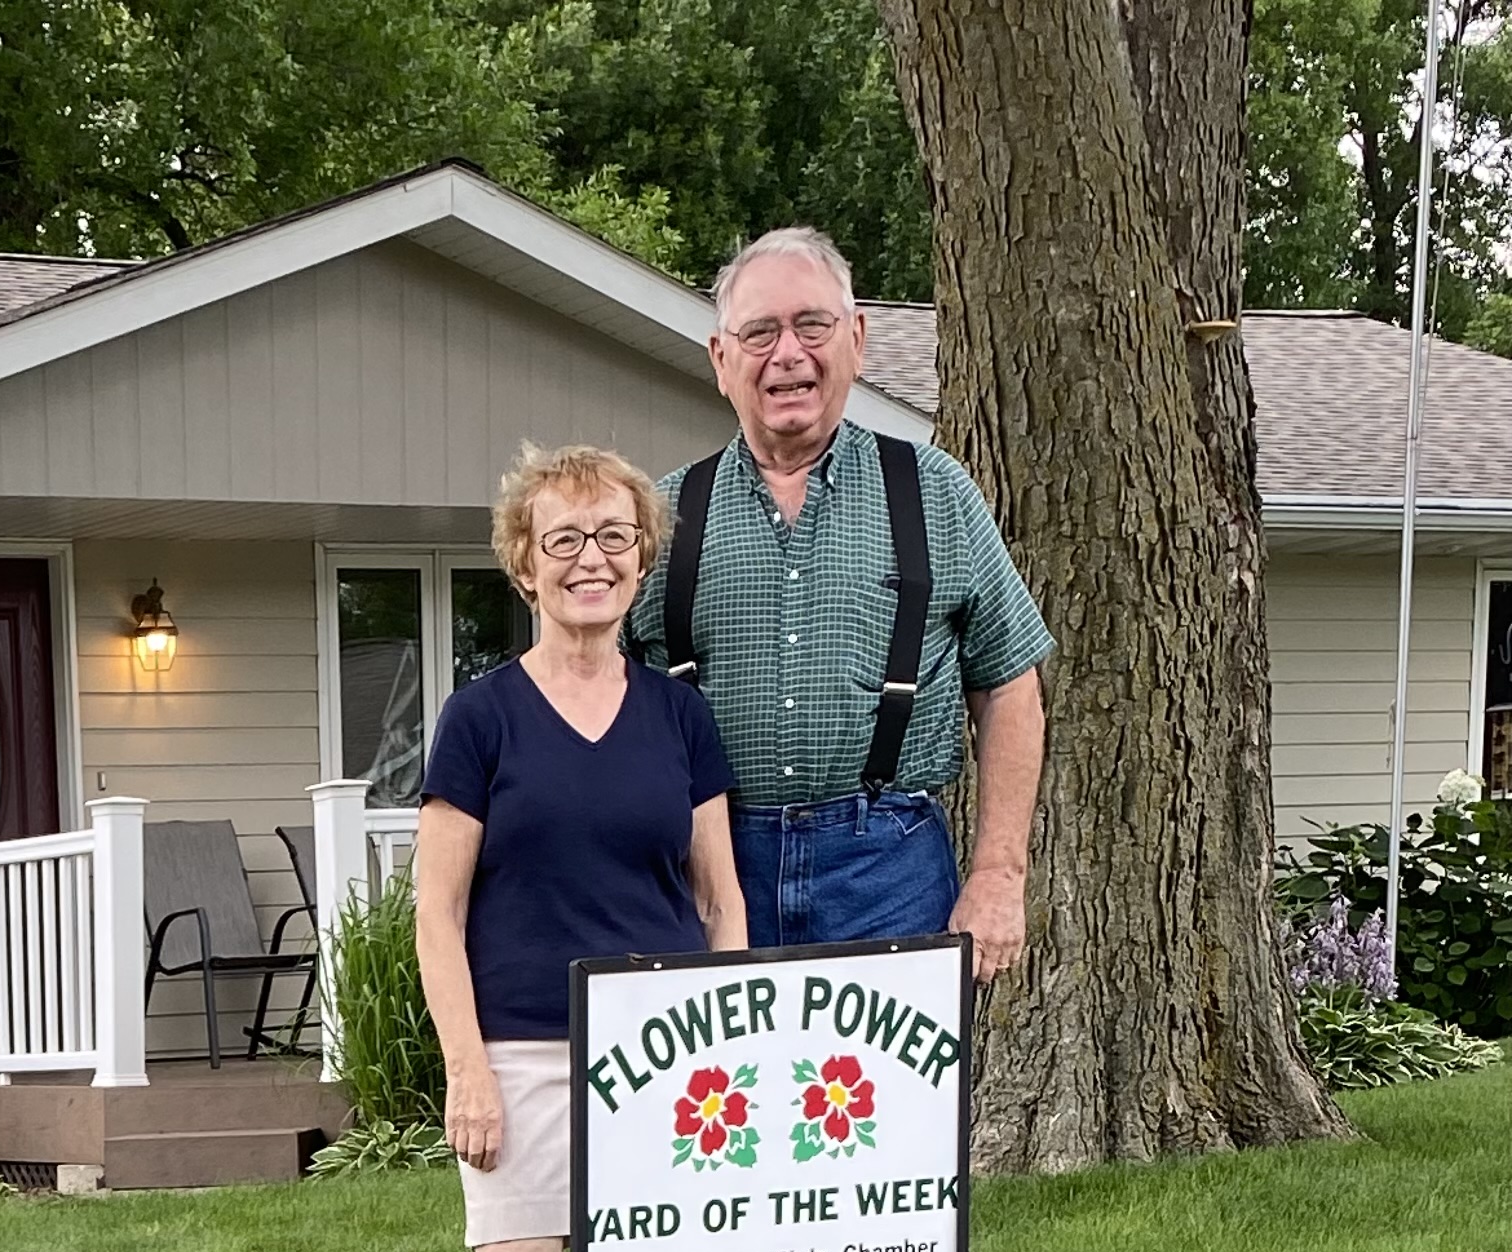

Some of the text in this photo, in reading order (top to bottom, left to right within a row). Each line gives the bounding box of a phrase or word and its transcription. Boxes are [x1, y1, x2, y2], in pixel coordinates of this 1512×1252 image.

[588, 976, 960, 1114] FLOWER POWER
[588, 1174, 959, 1243] YARD OF THE WEEK
